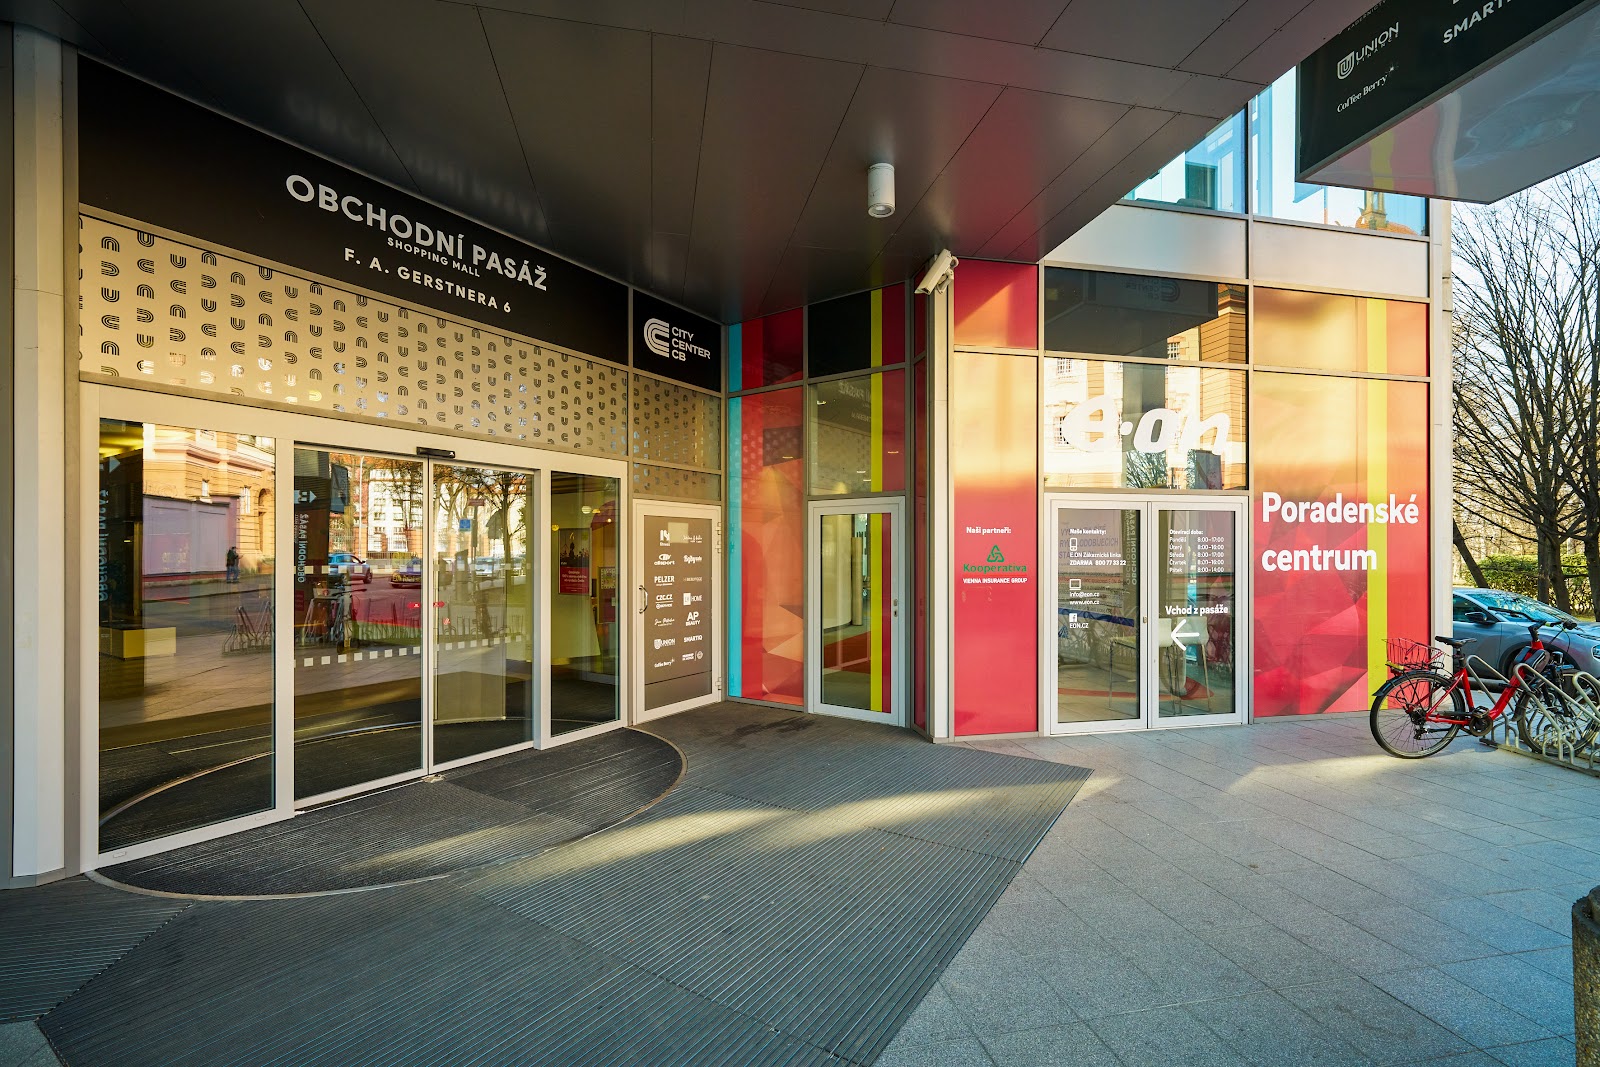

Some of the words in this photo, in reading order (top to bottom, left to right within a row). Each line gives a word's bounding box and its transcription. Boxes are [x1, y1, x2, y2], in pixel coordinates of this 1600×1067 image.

[1443, 0, 1511, 43] SMART
[1356, 22, 1399, 61] UNION
[1356, 33, 1399, 66] FINANCE
[1336, 92, 1362, 113] Coffee
[1363, 74, 1388, 96] Berry
[286, 174, 464, 259] OBCHODNÍ
[473, 244, 547, 291] PASÁŽ
[387, 237, 449, 266] SHOPPING
[452, 260, 480, 278] MALL
[344, 247, 361, 265] F.
[369, 256, 389, 274] A.
[397, 265, 498, 310] GERSTNERA
[503, 301, 511, 313] 6
[671, 326, 694, 341] CITY
[671, 338, 711, 360] CENTER
[671, 349, 686, 362] CB
[1262, 491, 1419, 525] Poradenské
[966, 526, 982, 534] Naši
[982, 526, 1012, 536] partneři:
[1083, 528, 1107, 536] kontakty:
[963, 563, 1027, 575] Kooperativa
[1261, 544, 1378, 572] centrum
[654, 575, 675, 583] PELZER
[687, 611, 699, 621] AP
[1165, 605, 1192, 615] Vchod
[1200, 604, 1229, 616] pasáže
